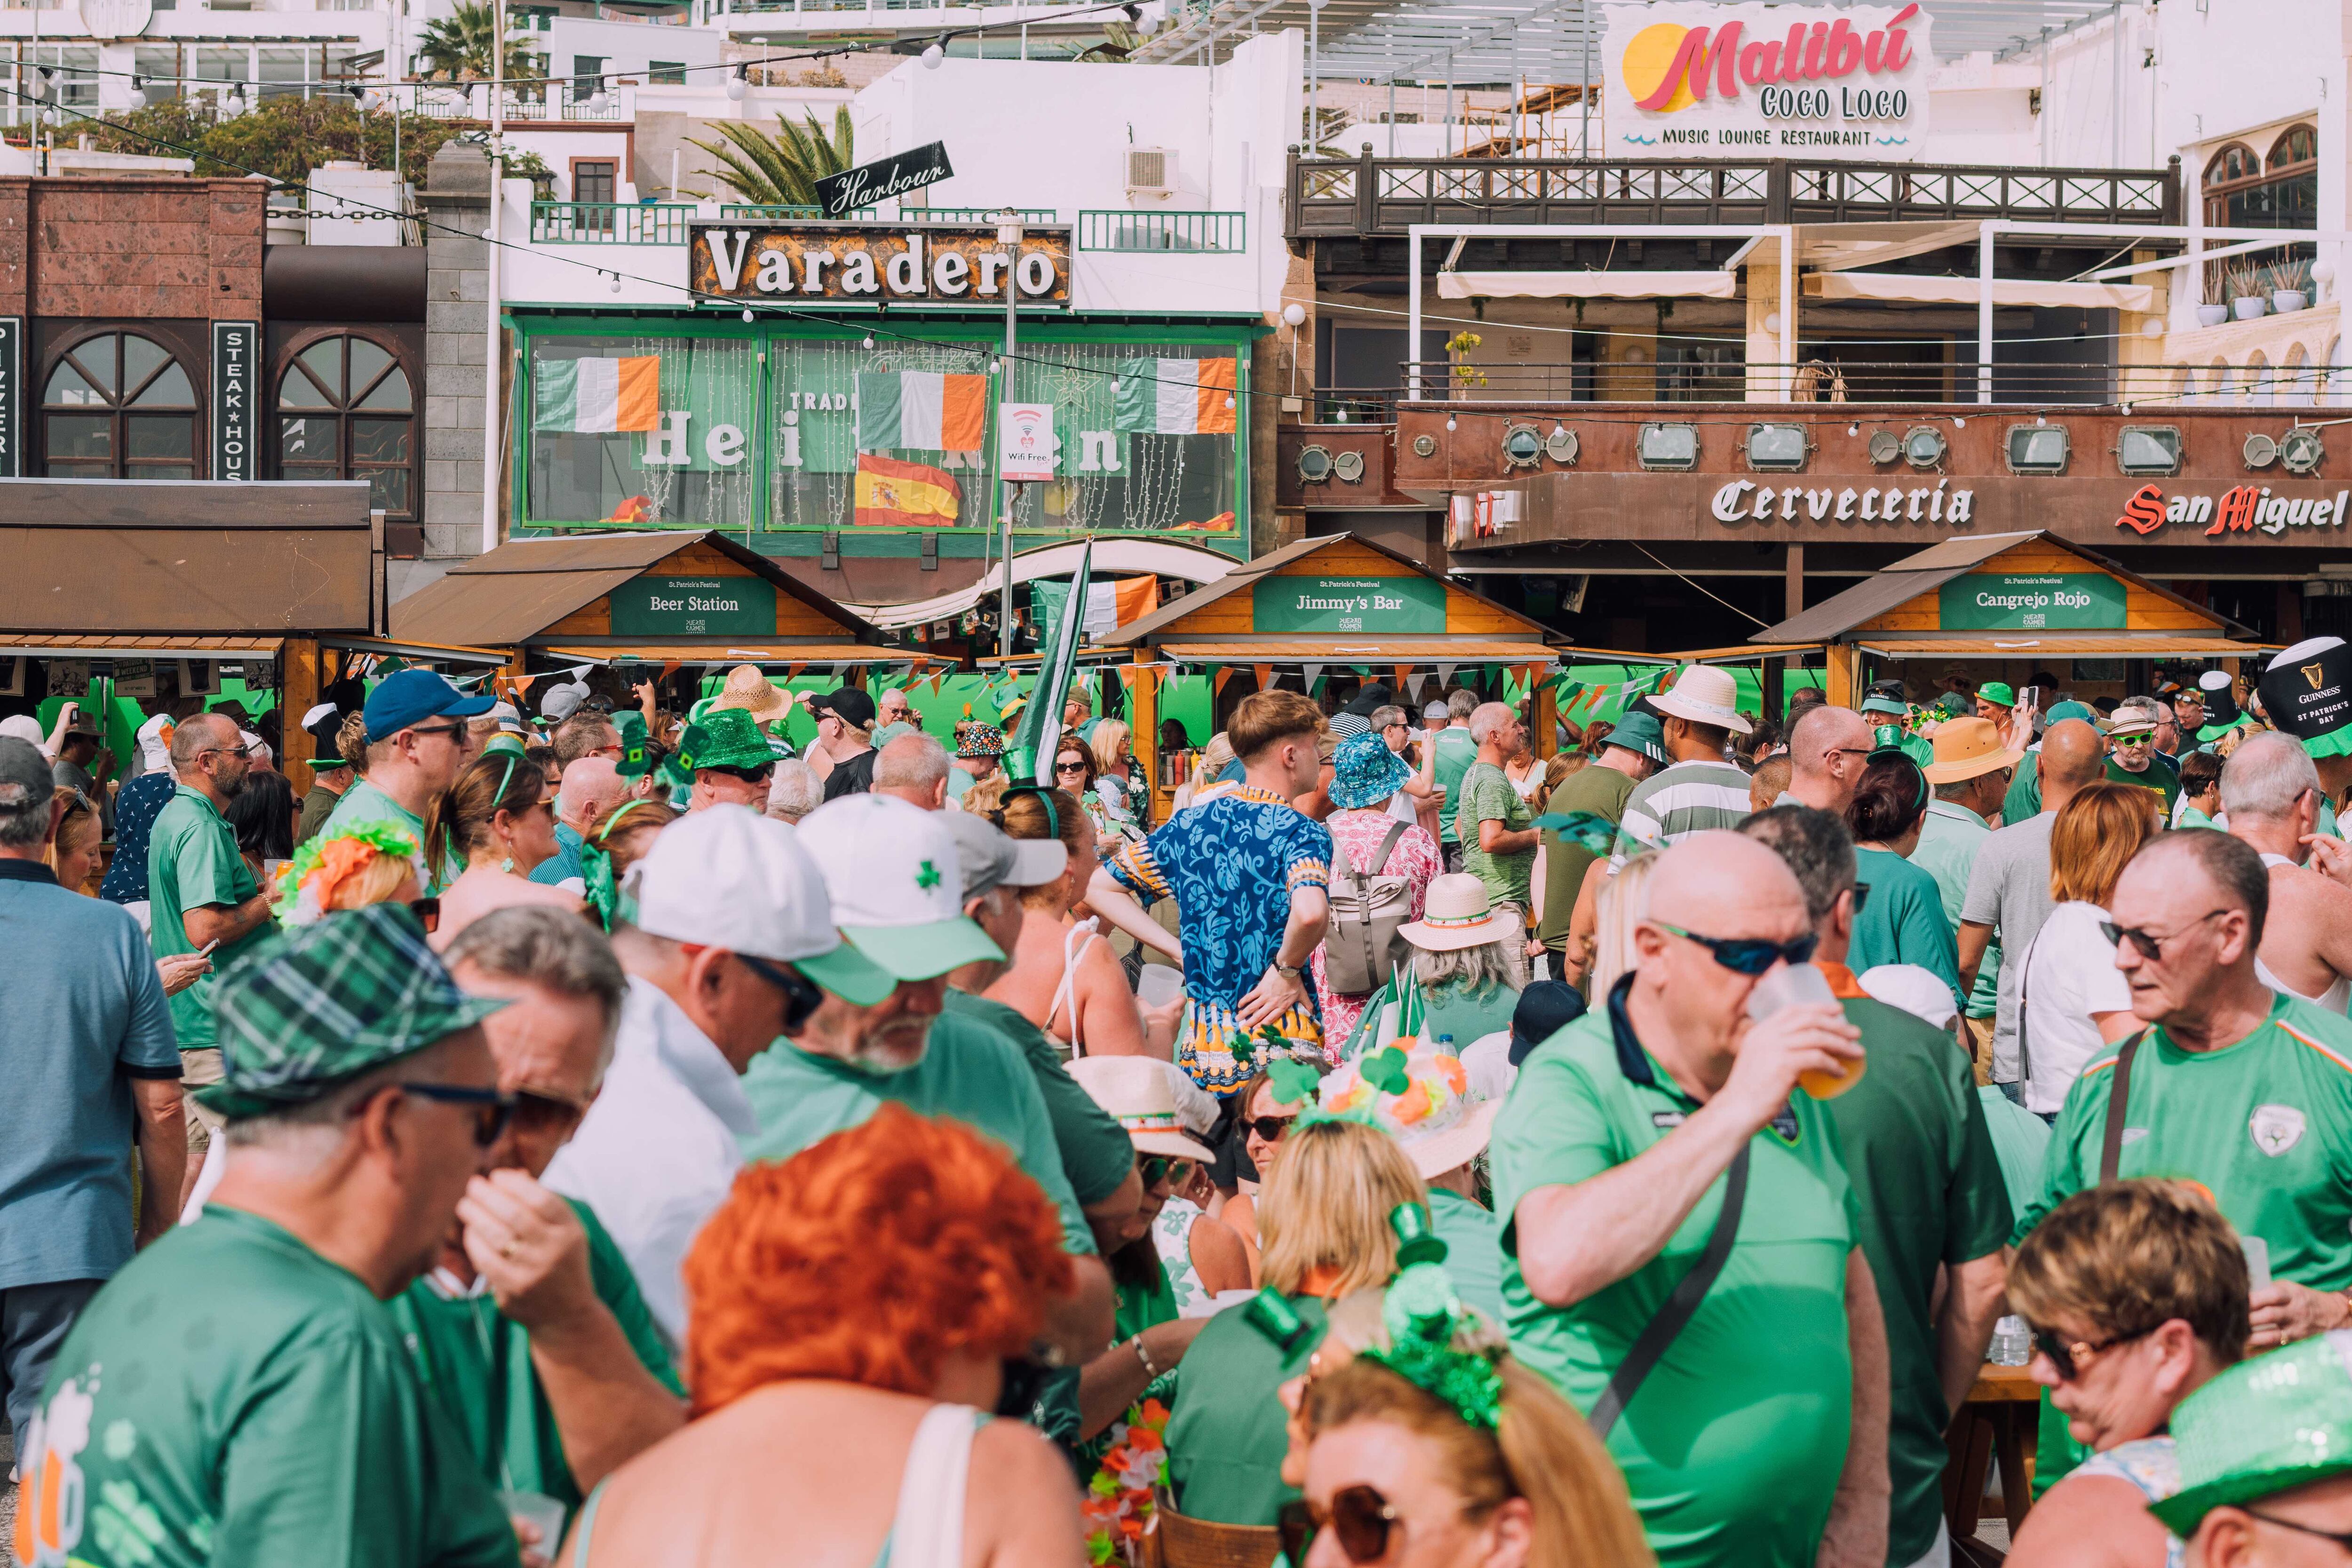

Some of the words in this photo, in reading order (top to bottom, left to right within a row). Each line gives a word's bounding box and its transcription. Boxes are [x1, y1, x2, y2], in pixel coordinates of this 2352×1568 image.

[1635, 2, 1919, 111] Malibú
[1760, 86, 1829, 119] COCO
[1842, 86, 1907, 119] LOCO
[1662, 129, 1708, 143] MUSIC
[1719, 129, 1771, 144] LOUNGE
[1781, 130, 1870, 145] RESTAURANT
[831, 164, 945, 213] Harbour
[705, 230, 1056, 295] Varadero
[225, 332, 243, 408] STEAK
[1711, 478, 1974, 523] Cervecería
[2115, 484, 2212, 535] San
[2205, 486, 2350, 538] Miguel
[650, 597, 684, 611] Beer
[688, 596, 739, 611] Station
[1296, 595, 1368, 613] Jimmy's
[1373, 596, 1403, 610] Bar
[1977, 592, 2049, 610] Cangrejo
[2053, 591, 2090, 609] Rojo
[2299, 686, 2341, 704] GUINNESS
[2310, 701, 2349, 718] PATRICK'S
[2319, 715, 2334, 724] DAY
